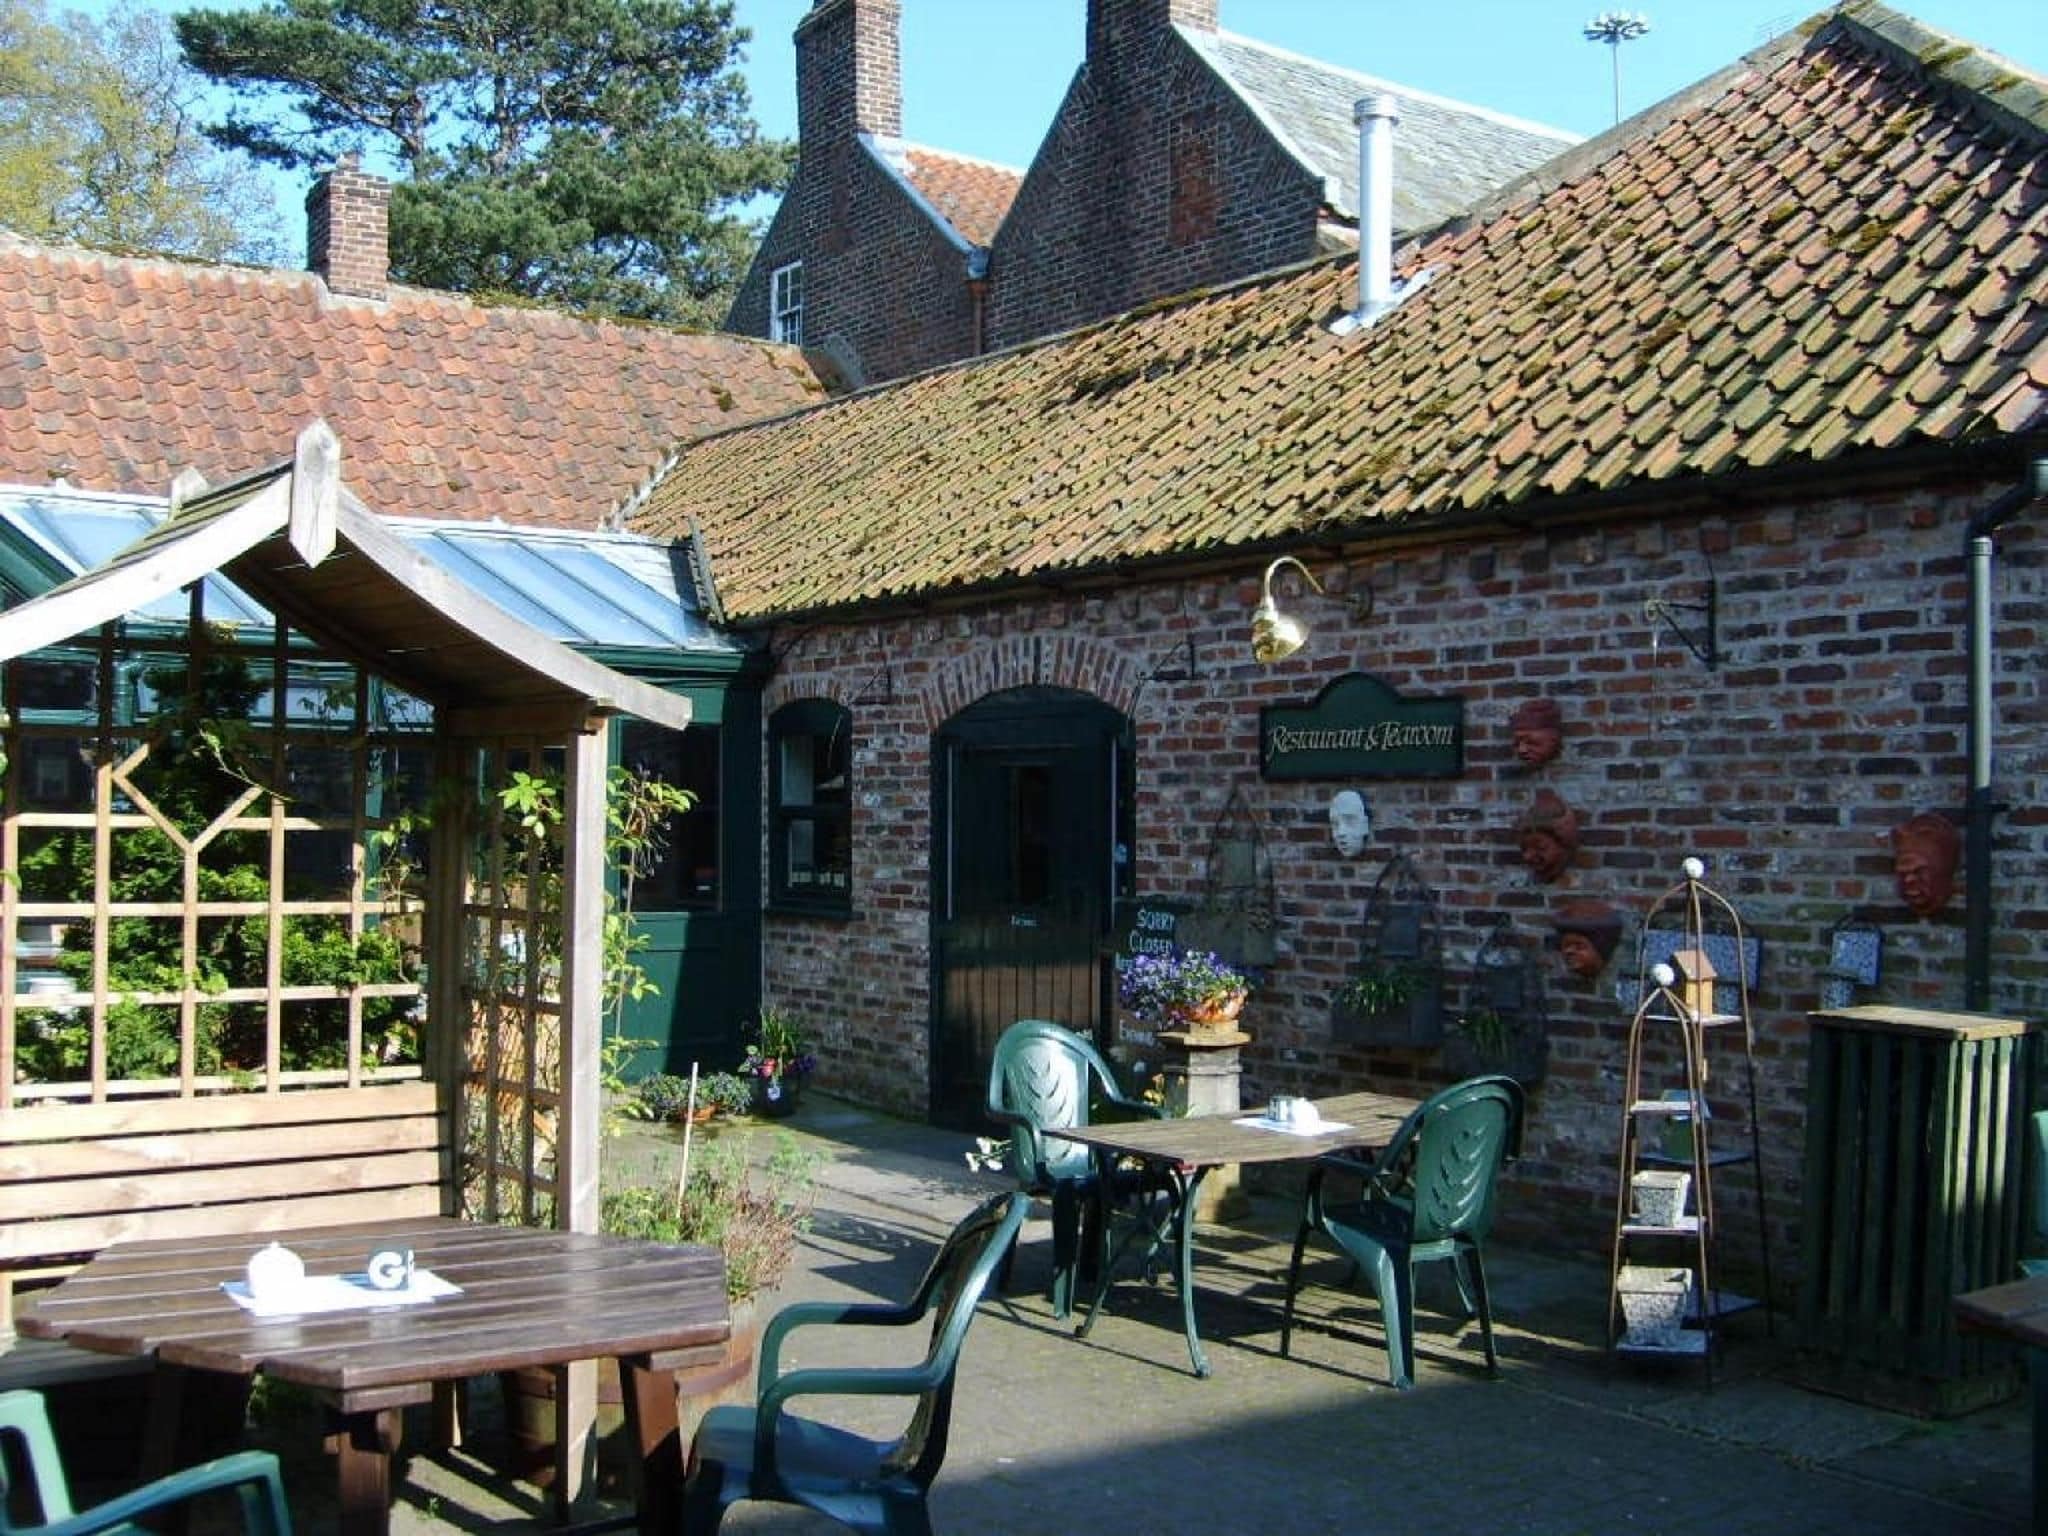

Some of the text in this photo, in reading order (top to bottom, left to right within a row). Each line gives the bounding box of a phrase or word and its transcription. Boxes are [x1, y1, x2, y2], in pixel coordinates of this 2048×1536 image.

[1266, 721, 1454, 762] Restaurant & Tearoom
